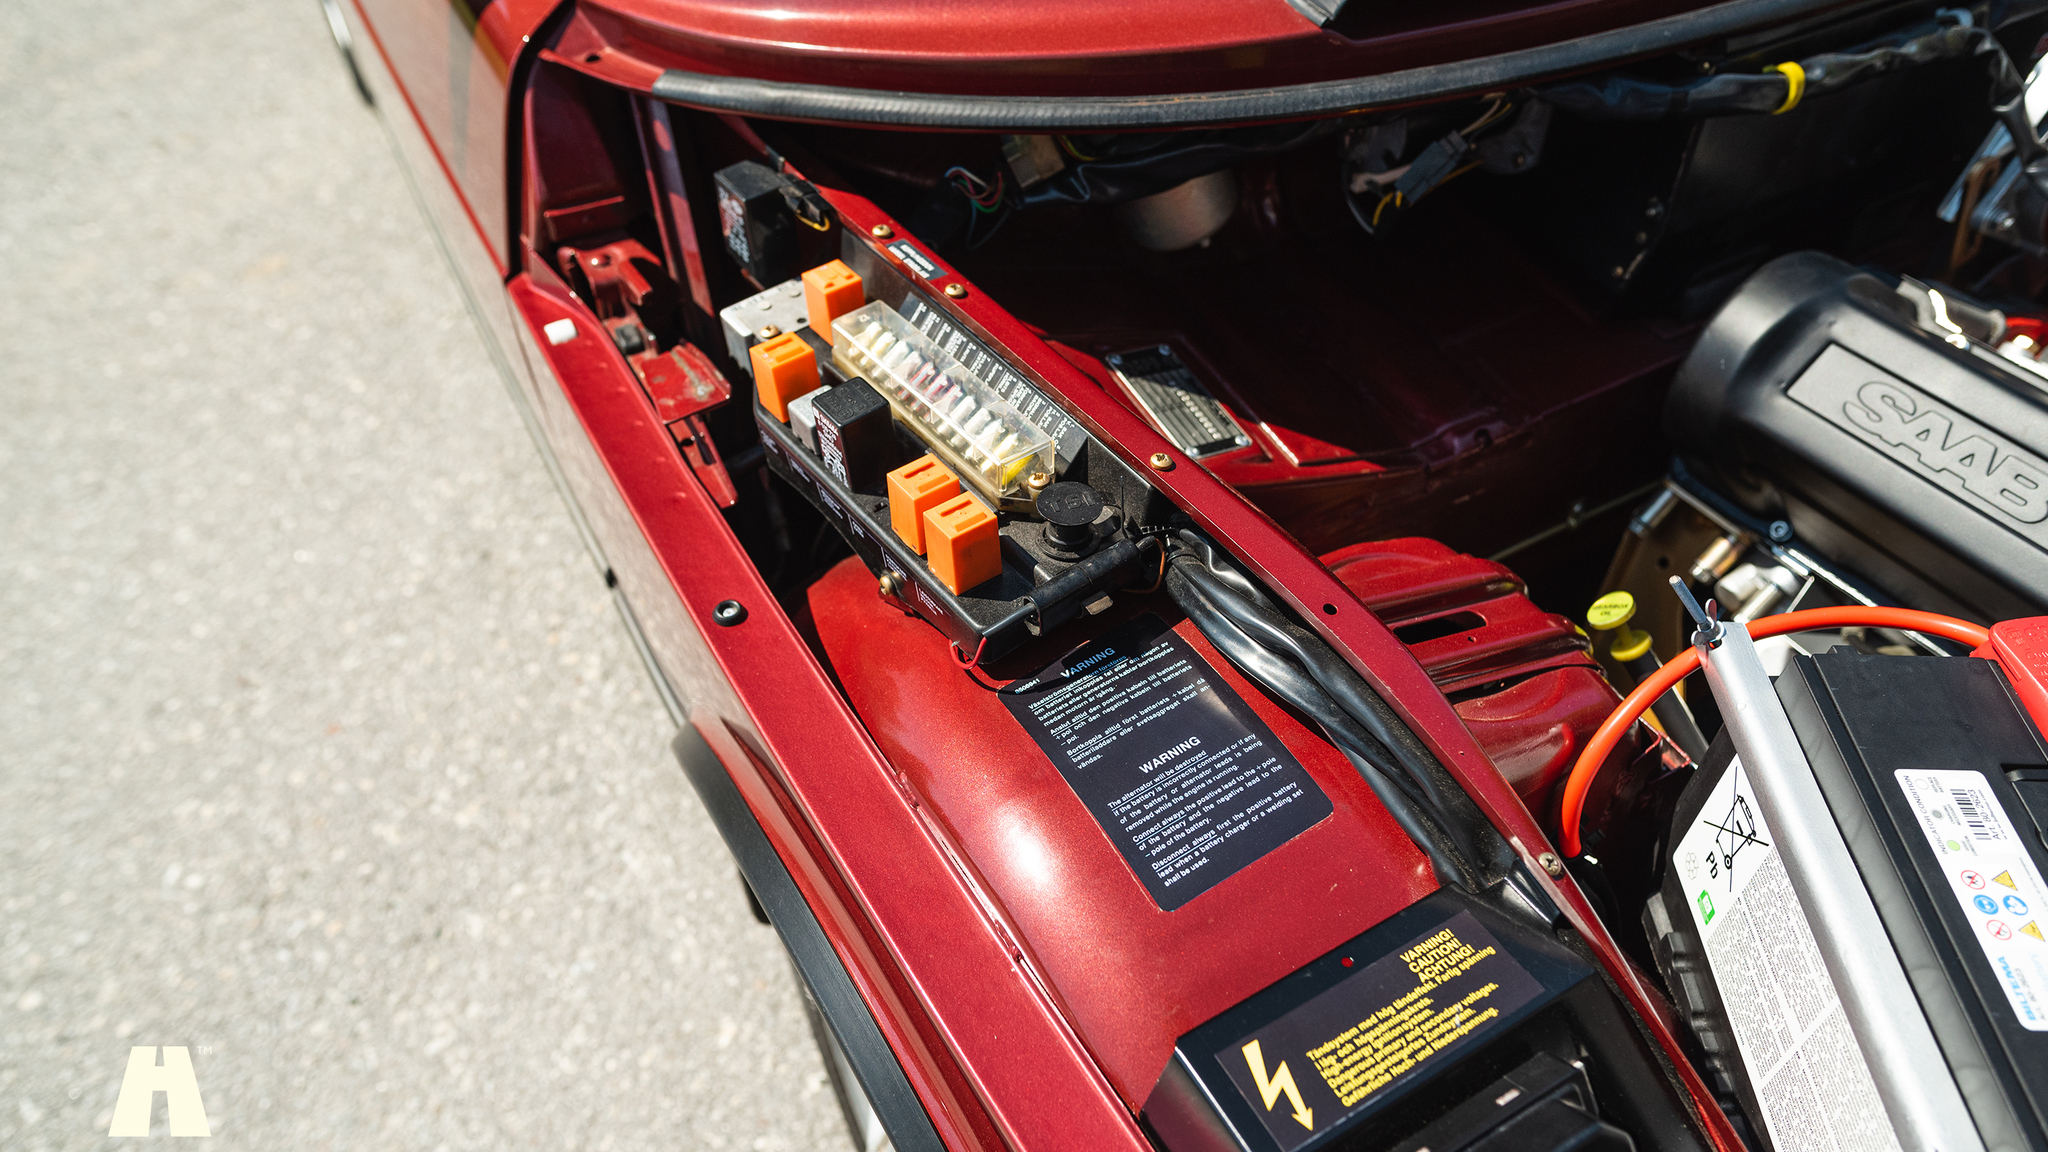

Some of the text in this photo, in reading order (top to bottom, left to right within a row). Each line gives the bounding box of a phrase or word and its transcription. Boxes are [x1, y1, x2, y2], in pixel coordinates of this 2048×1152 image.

[1841, 380, 2048, 524] SAAB
[1060, 648, 1114, 677] VARNING
[1107, 799, 1121, 808] The
[1121, 780, 1152, 801] alternator
[1153, 772, 1165, 782] will
[1174, 750, 1206, 770] destroyed
[1119, 733, 1255, 812] the battery incorrectly connected any
[1129, 740, 1262, 817] the battery alternator leads being
[1139, 736, 1200, 772] WARNING
[1125, 764, 1239, 831] removed while the engine running.
[1132, 822, 1161, 842] Connect
[1161, 809, 1185, 825] always
[1184, 802, 1196, 811] the
[1196, 788, 1221, 806] positive
[1221, 778, 1236, 789] lead
[1243, 768, 1255, 777] the
[1138, 842, 1146, 850] of
[1147, 835, 1160, 844] the
[1161, 820, 1186, 836] battery
[1188, 810, 1201, 821] and
[1202, 803, 1214, 812] the
[1216, 786, 1243, 804] negative
[1244, 775, 1260, 787] lead
[1270, 764, 1282, 772] the
[1151, 781, 1296, 869] Disconnect always first the positive battery
[1903, 775, 1948, 854] INDICATOR CONDITION
[1967, 789, 2000, 839] Art. 80-2623
[1157, 788, 1303, 878] lead when battery charger welding set
[1166, 837, 1174, 845] of
[1173, 831, 1185, 840] the
[1184, 817, 1211, 834] battery.
[1164, 856, 1209, 886] shall be used.
[1706, 851, 1718, 880] Pb
[1400, 928, 1453, 962] VARNING!
[1408, 938, 1461, 972] CAUTION!
[1418, 944, 1474, 982] ACHTUNG!
[1358, 1014, 1378, 1030] med
[1375, 1005, 1396, 1019] hög
[1434, 967, 1461, 984] Farlig
[1458, 946, 1495, 970] spänning
[1998, 956, 2035, 1020] BILTEMA
[1327, 982, 1498, 1089] Dangerous primary and secondary voltages.
[1336, 1043, 1355, 1057] och
[1414, 1045, 1433, 1061] und
